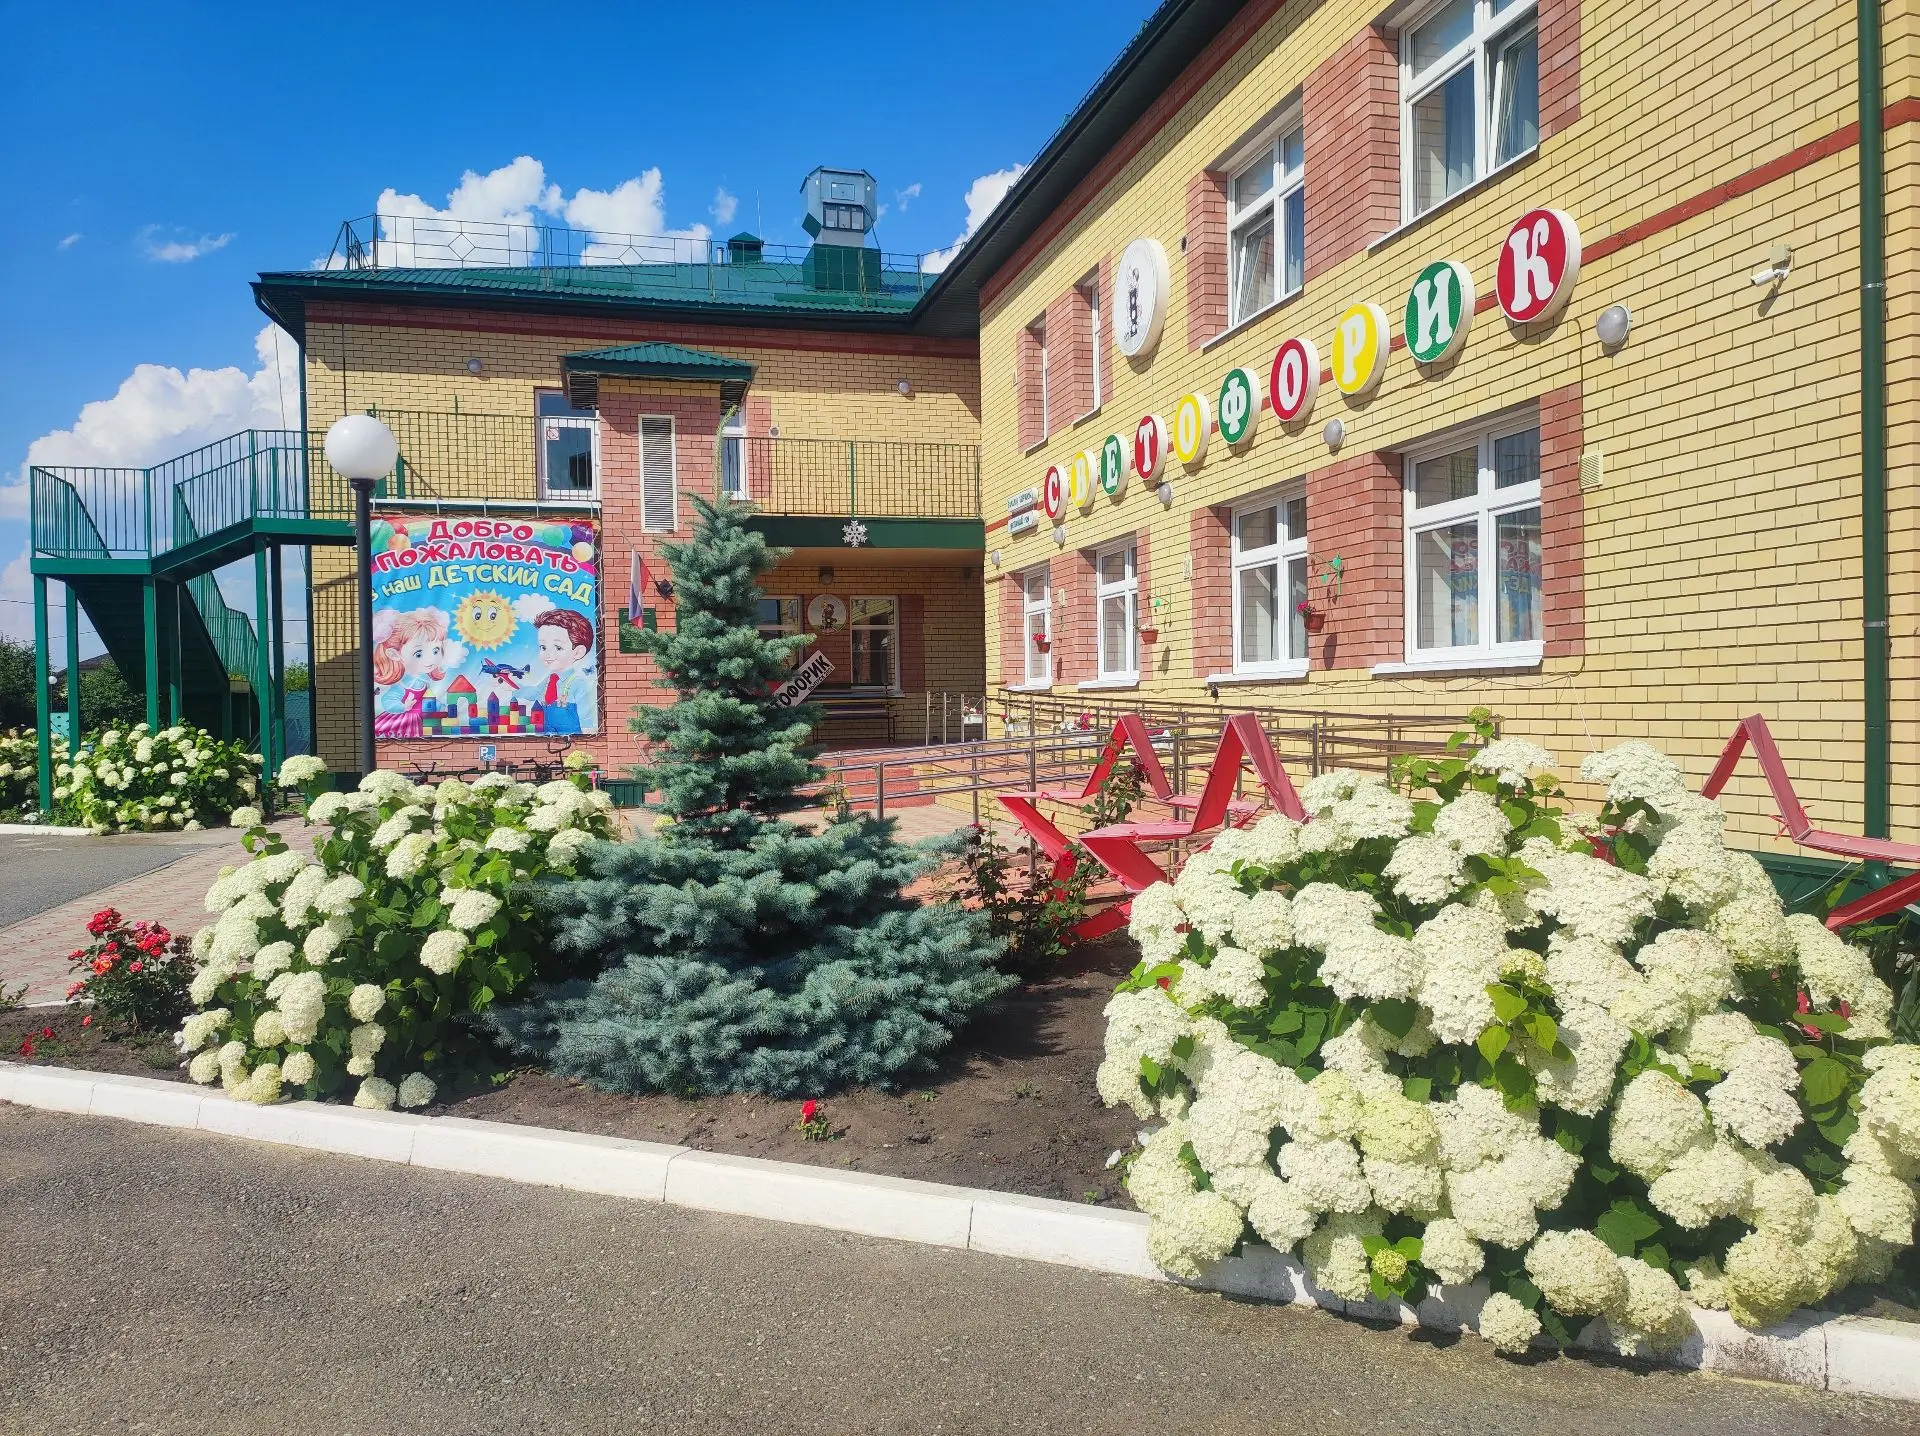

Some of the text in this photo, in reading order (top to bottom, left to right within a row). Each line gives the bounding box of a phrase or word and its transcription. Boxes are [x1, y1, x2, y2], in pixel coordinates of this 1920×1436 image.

[1047, 218, 1554, 513] СВЕТОФОРИК
[427, 520, 534, 542] ДОБРО
[376, 541, 579, 572] ПОЖАЛОВАТЬ
[381, 574, 422, 597] наш
[427, 564, 540, 589] ДЕТСКИЙ
[543, 574, 593, 607] САД
